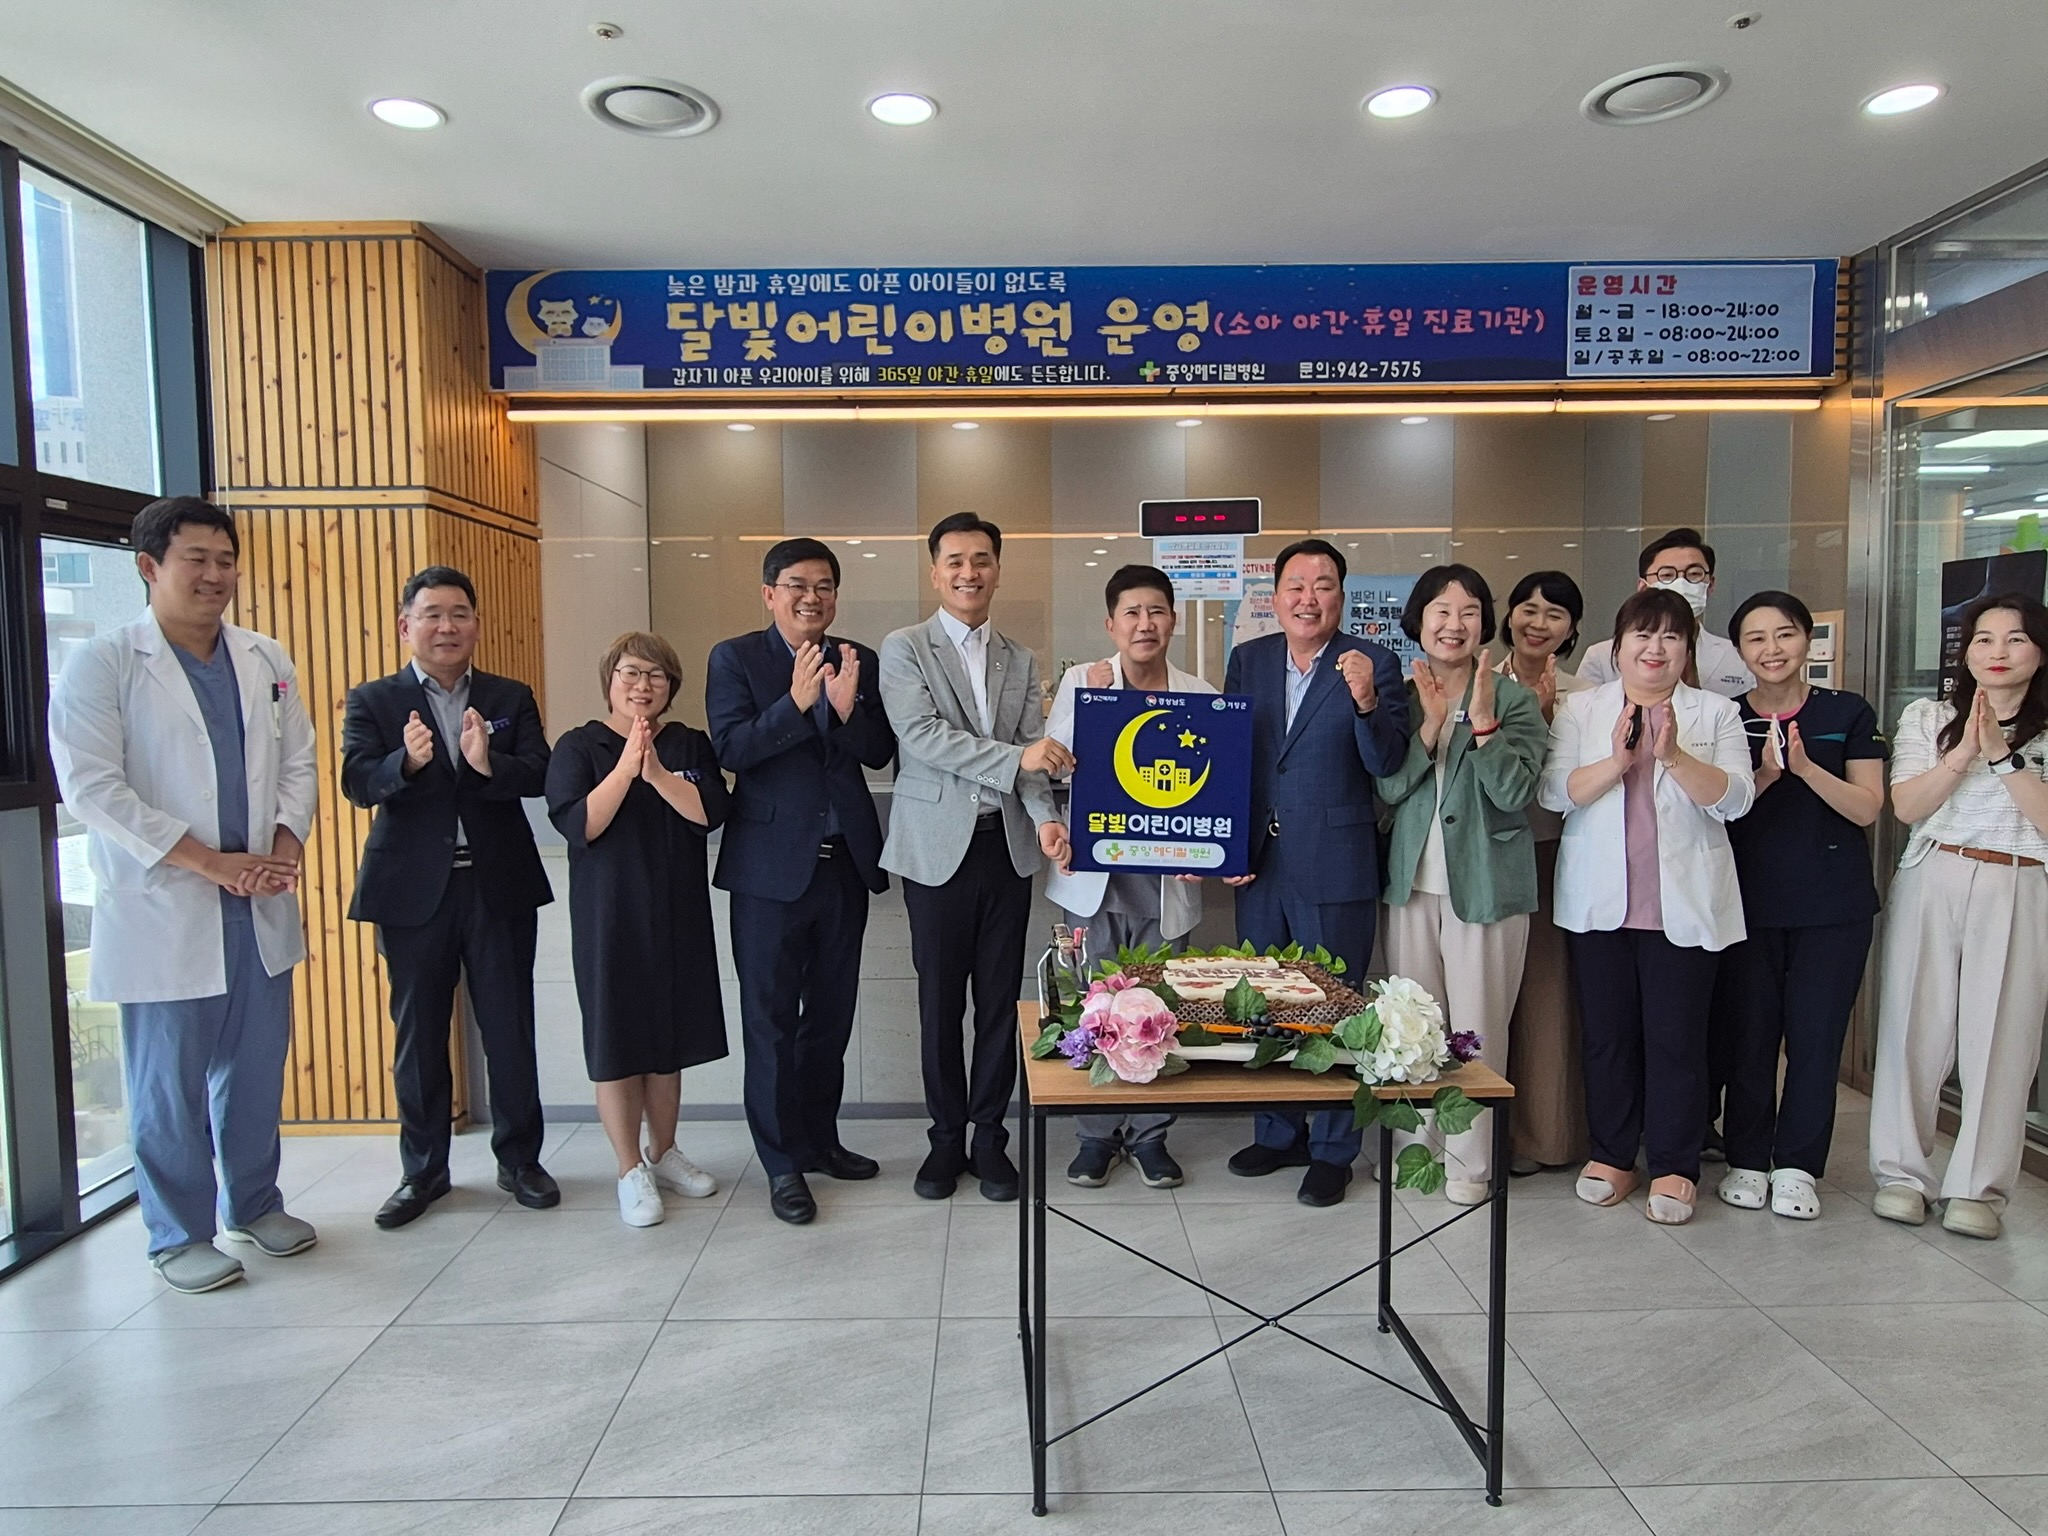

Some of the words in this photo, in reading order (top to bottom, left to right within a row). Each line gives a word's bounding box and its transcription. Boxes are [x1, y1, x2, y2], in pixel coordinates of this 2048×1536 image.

[668, 274, 706, 296] 늦은
[714, 274, 759, 296] 밤과
[767, 273, 852, 296] 휴일에도
[859, 272, 901, 295] 아픈
[909, 272, 996, 294] 아이들이
[1004, 271, 1067, 294] 없도록
[1576, 274, 1678, 296] 운영시간
[666, 299, 1073, 363] 달빛어린이병원
[1096, 297, 1210, 356] 운영
[1292, 306, 1413, 337] 야간·휴일
[1423, 306, 1545, 336] 진료기관)
[1574, 326, 1635, 343] 토요일
[671, 367, 718, 386] 갑자기
[723, 367, 754, 385] 아픈
[758, 366, 833, 384] 우리아이를
[838, 366, 870, 383] 위해
[877, 366, 923, 384] 365일
[927, 365, 1024, 384] 야간·휴일에도
[1031, 364, 1111, 382] 든든합니다.
[1166, 363, 1265, 382] 중앙메디컬병원
[1300, 360, 1422, 379] 문의:942-7575
[1350, 590, 1375, 604] 병원
[1379, 590, 1391, 604] 내
[1158, 697, 1186, 707] 경상남도
[1088, 812, 1232, 838] 달빛어린이병원
